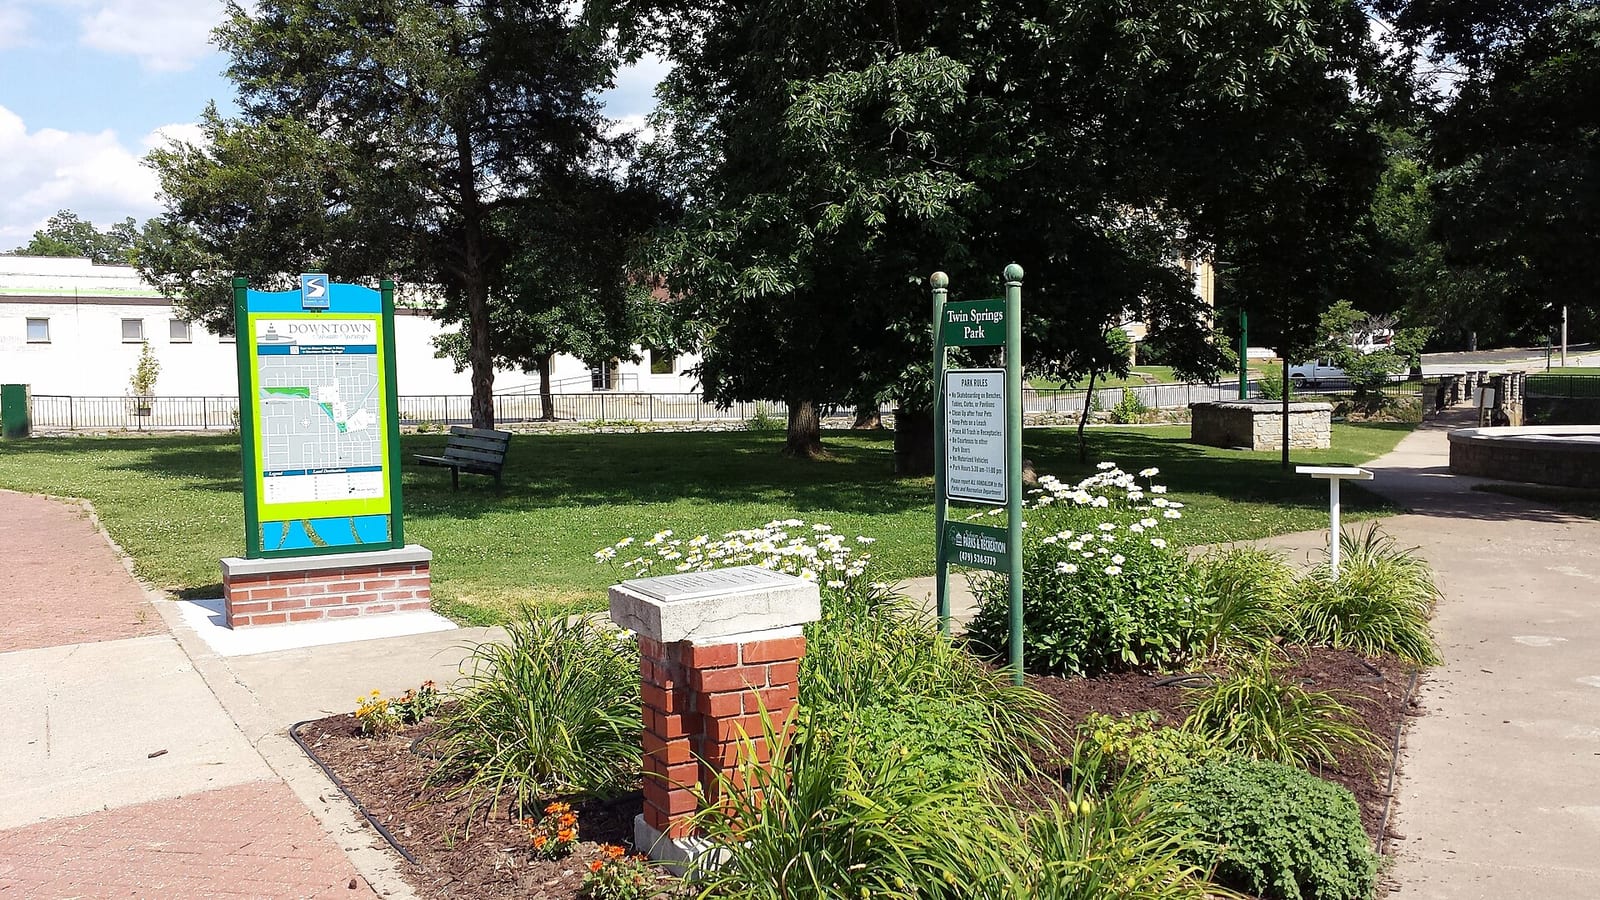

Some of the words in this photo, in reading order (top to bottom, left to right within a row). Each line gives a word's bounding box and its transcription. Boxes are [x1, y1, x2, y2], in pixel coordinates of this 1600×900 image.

[947, 310, 968, 323] Twin
[970, 308, 1003, 324] Springs
[288, 323, 372, 335] DOWNTOWN
[964, 325, 985, 339] Park
[961, 379, 973, 387] PARK
[974, 379, 988, 387] RULES
[963, 536, 976, 549] PARKS
[976, 539, 980, 550] &
[981, 539, 1006, 554] RECREATION
[959, 551, 973, 564] (479)
